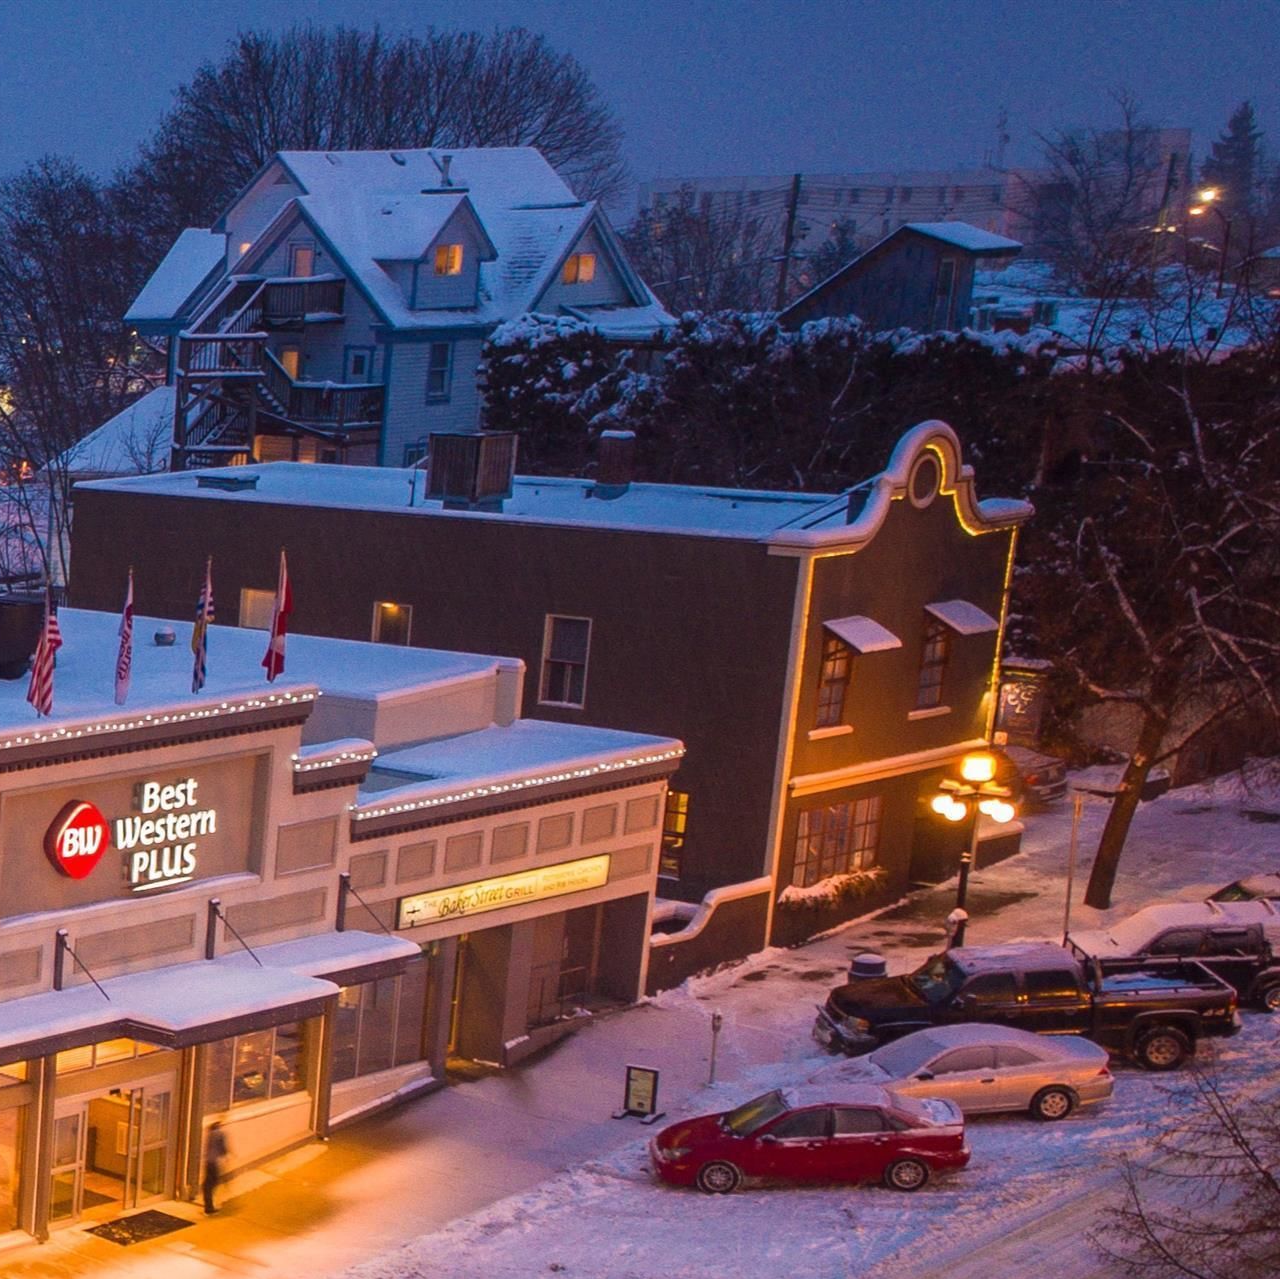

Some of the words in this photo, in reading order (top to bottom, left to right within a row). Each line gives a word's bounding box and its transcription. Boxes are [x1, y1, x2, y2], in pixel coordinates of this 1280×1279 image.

[142, 778, 198, 814] Best
[62, 825, 102, 858] BW
[116, 809, 217, 850] Western
[131, 843, 197, 884] PLUS
[438, 890, 473, 918] Baker
[471, 884, 505, 908] Street
[505, 885, 534, 899] GRILL
